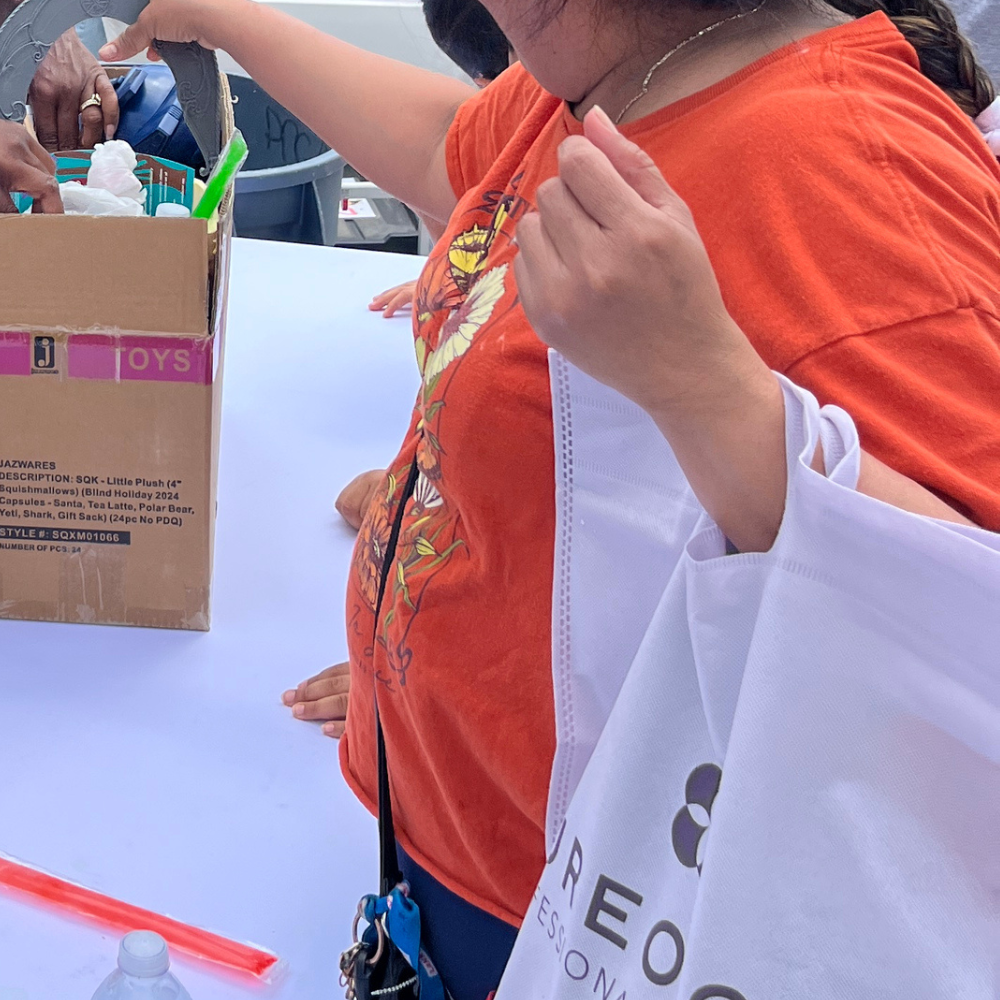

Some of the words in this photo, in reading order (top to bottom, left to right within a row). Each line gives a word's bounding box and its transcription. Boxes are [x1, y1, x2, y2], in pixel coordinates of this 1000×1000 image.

[76, 475, 99, 485] SQK
[107, 477, 133, 486] Little
[135, 478, 164, 487] Plush
[166, 480, 182, 489] (4"
[81, 488, 112, 498] (Blind
[114, 489, 153, 501] Holiday
[155, 491, 179, 500] 2024
[53, 499, 85, 509] Santa,
[87, 500, 106, 509] Tea
[107, 501, 137, 512] Latte,
[139, 502, 166, 512] Polar
[168, 504, 195, 515] Bear,
[23, 509, 55, 520] Shark,
[58, 511, 77, 520] Gift
[79, 512, 107, 523] Sack)
[109, 514, 137, 525] (24pc
[139, 515, 154, 524] No
[156, 516, 182, 527] PDQ)
[0, 527, 36, 538] STYLE
[52, 530, 120, 543] SQXM01066
